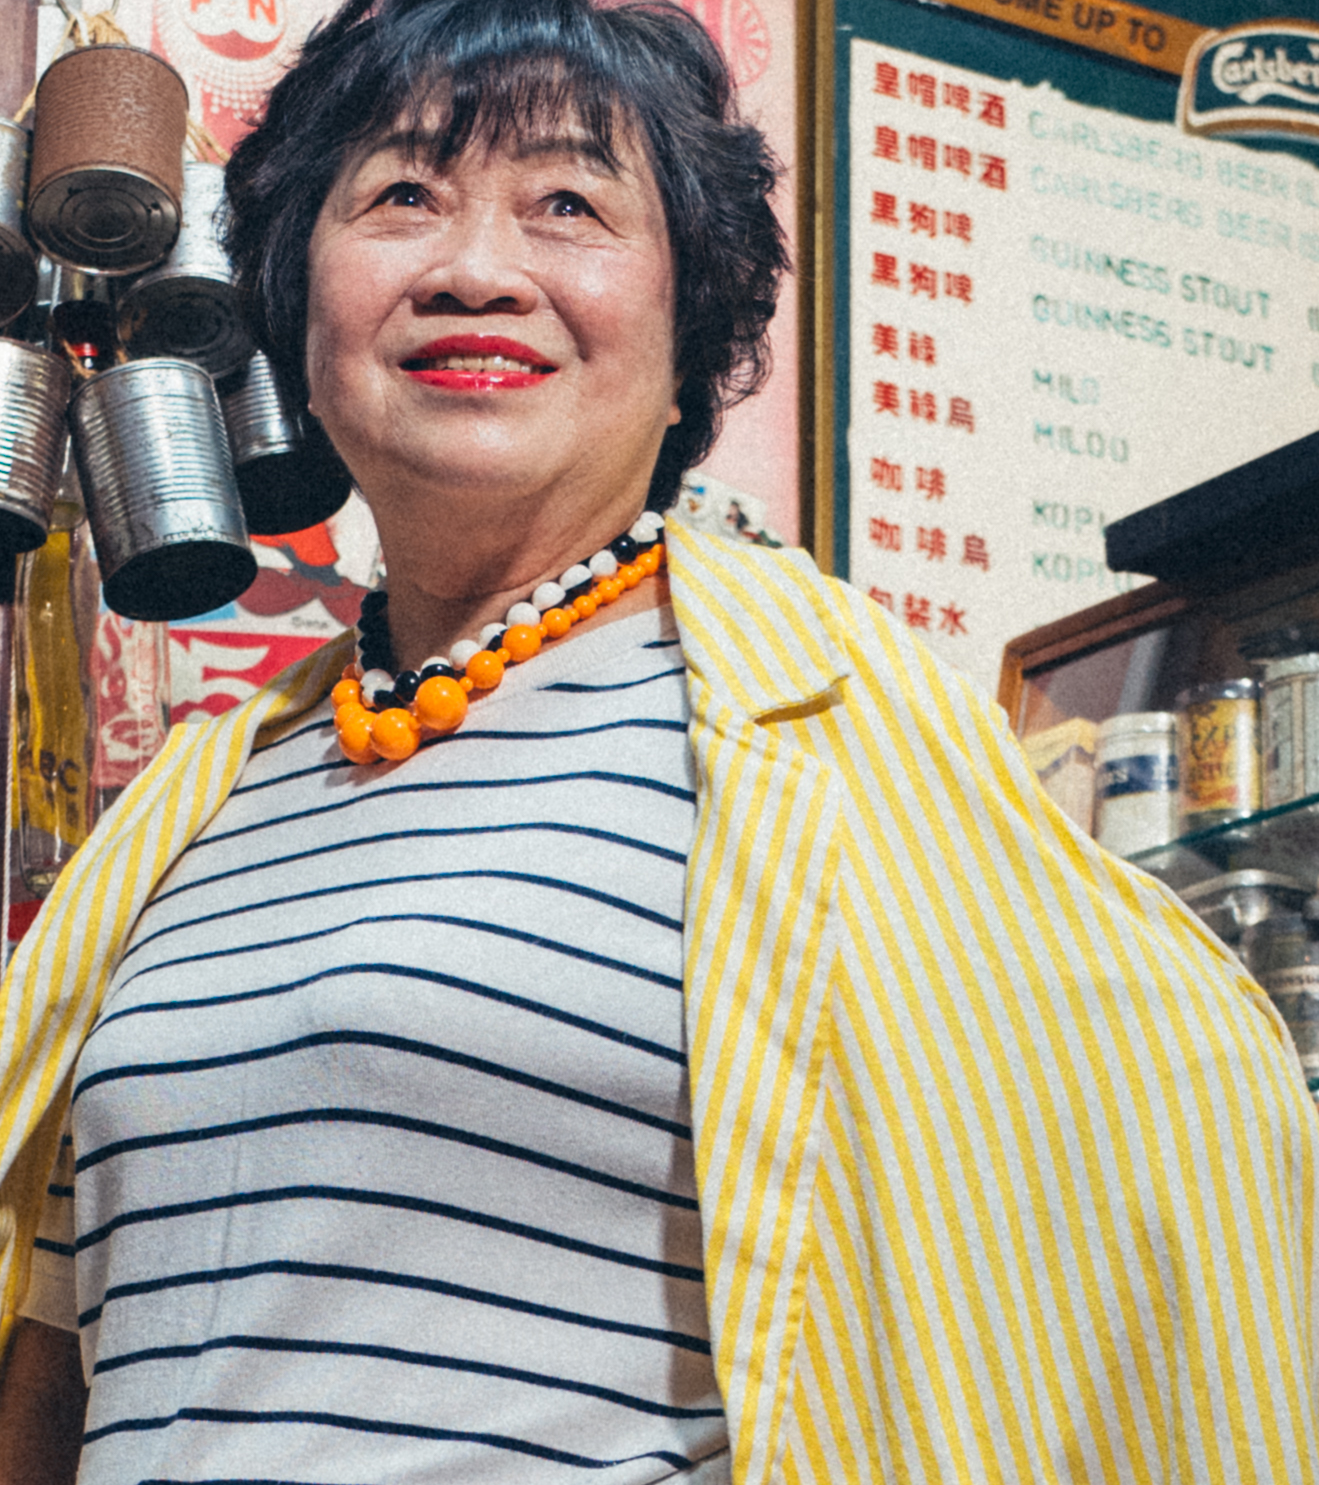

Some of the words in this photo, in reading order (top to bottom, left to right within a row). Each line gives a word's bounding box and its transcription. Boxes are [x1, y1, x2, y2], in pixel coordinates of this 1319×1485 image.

[1072, 3, 1117, 34] UP
[1126, 17, 1168, 53] TO
[1180, 274, 1272, 320] STOUT
[1183, 327, 1275, 373] STOUT
